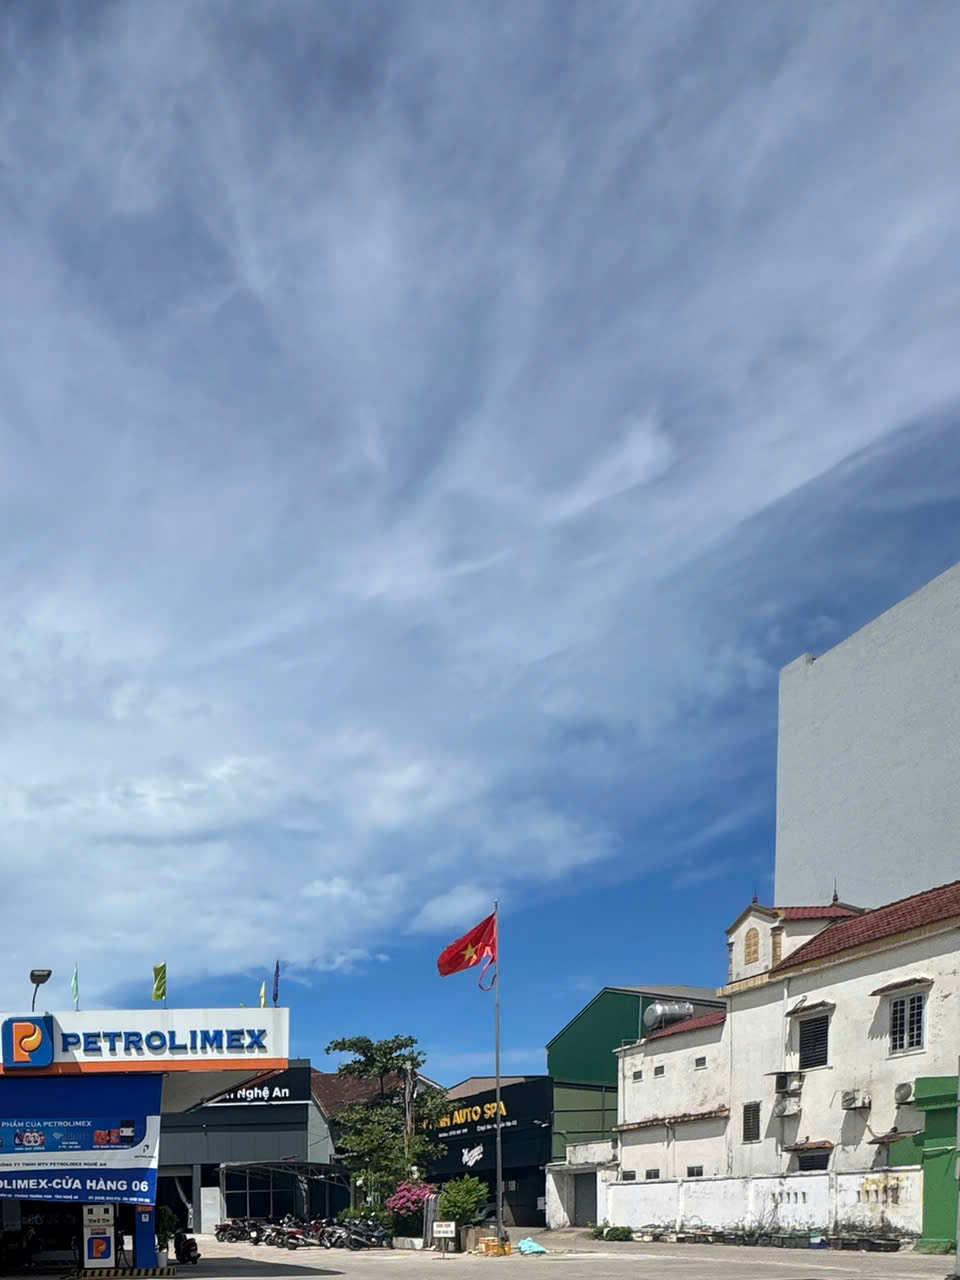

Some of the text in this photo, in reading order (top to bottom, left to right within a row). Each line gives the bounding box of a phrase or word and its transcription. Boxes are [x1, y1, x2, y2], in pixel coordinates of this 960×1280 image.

[61, 1029, 266, 1052] PETROLIMEX
[237, 1086, 269, 1100] Nghệ
[272, 1087, 289, 1098] An
[453, 1106, 480, 1125] AUTO
[484, 1101, 507, 1119] SPA
[86, 1178, 127, 1190] HÀNG
[132, 1181, 149, 1192] 06
